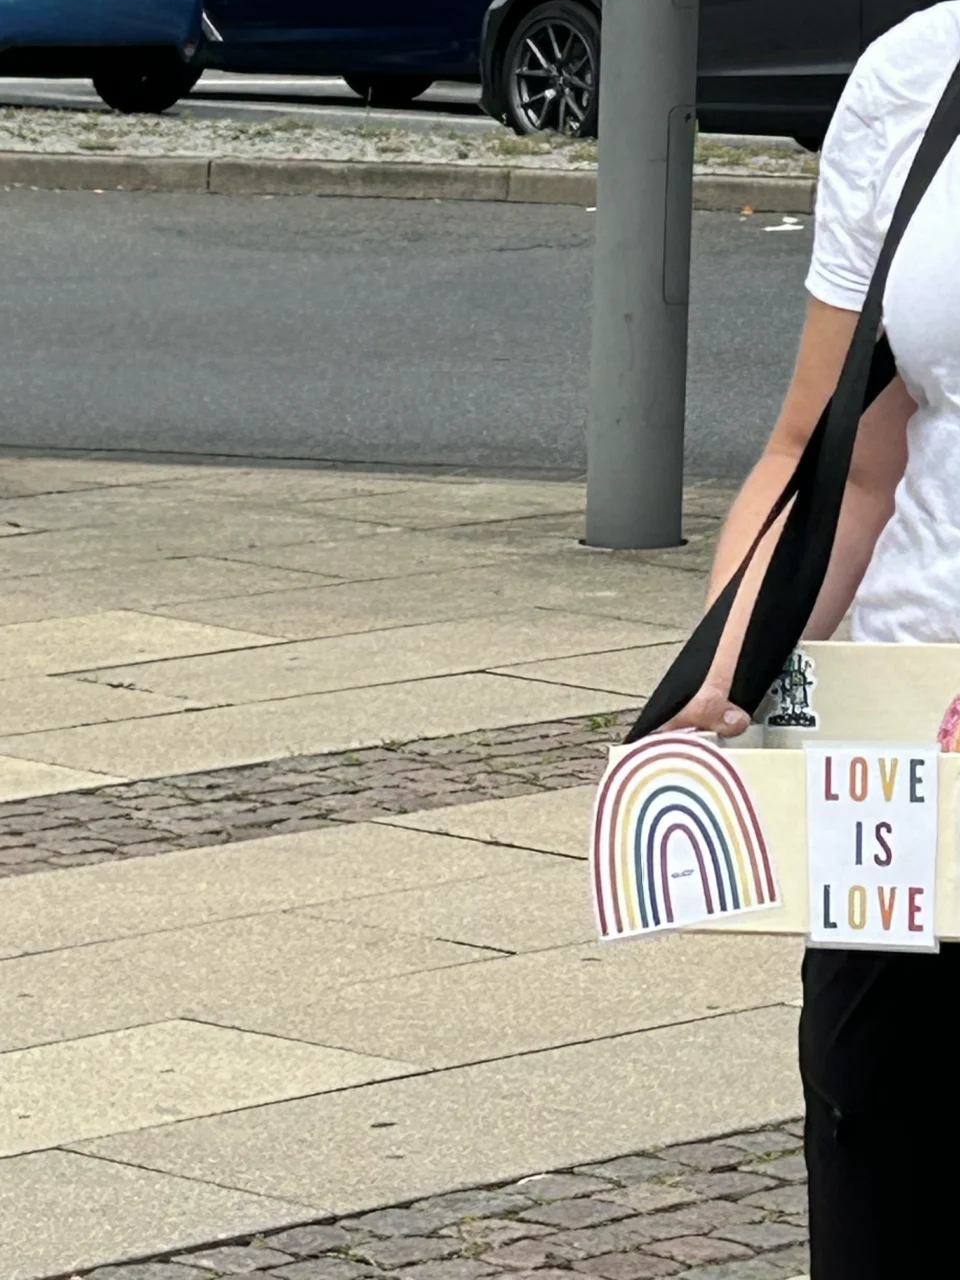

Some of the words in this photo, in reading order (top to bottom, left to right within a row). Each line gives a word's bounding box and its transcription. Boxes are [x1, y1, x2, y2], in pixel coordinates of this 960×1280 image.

[824, 755, 926, 804] LOVE
[854, 820, 893, 868] IS
[823, 884, 925, 933] LOVE
